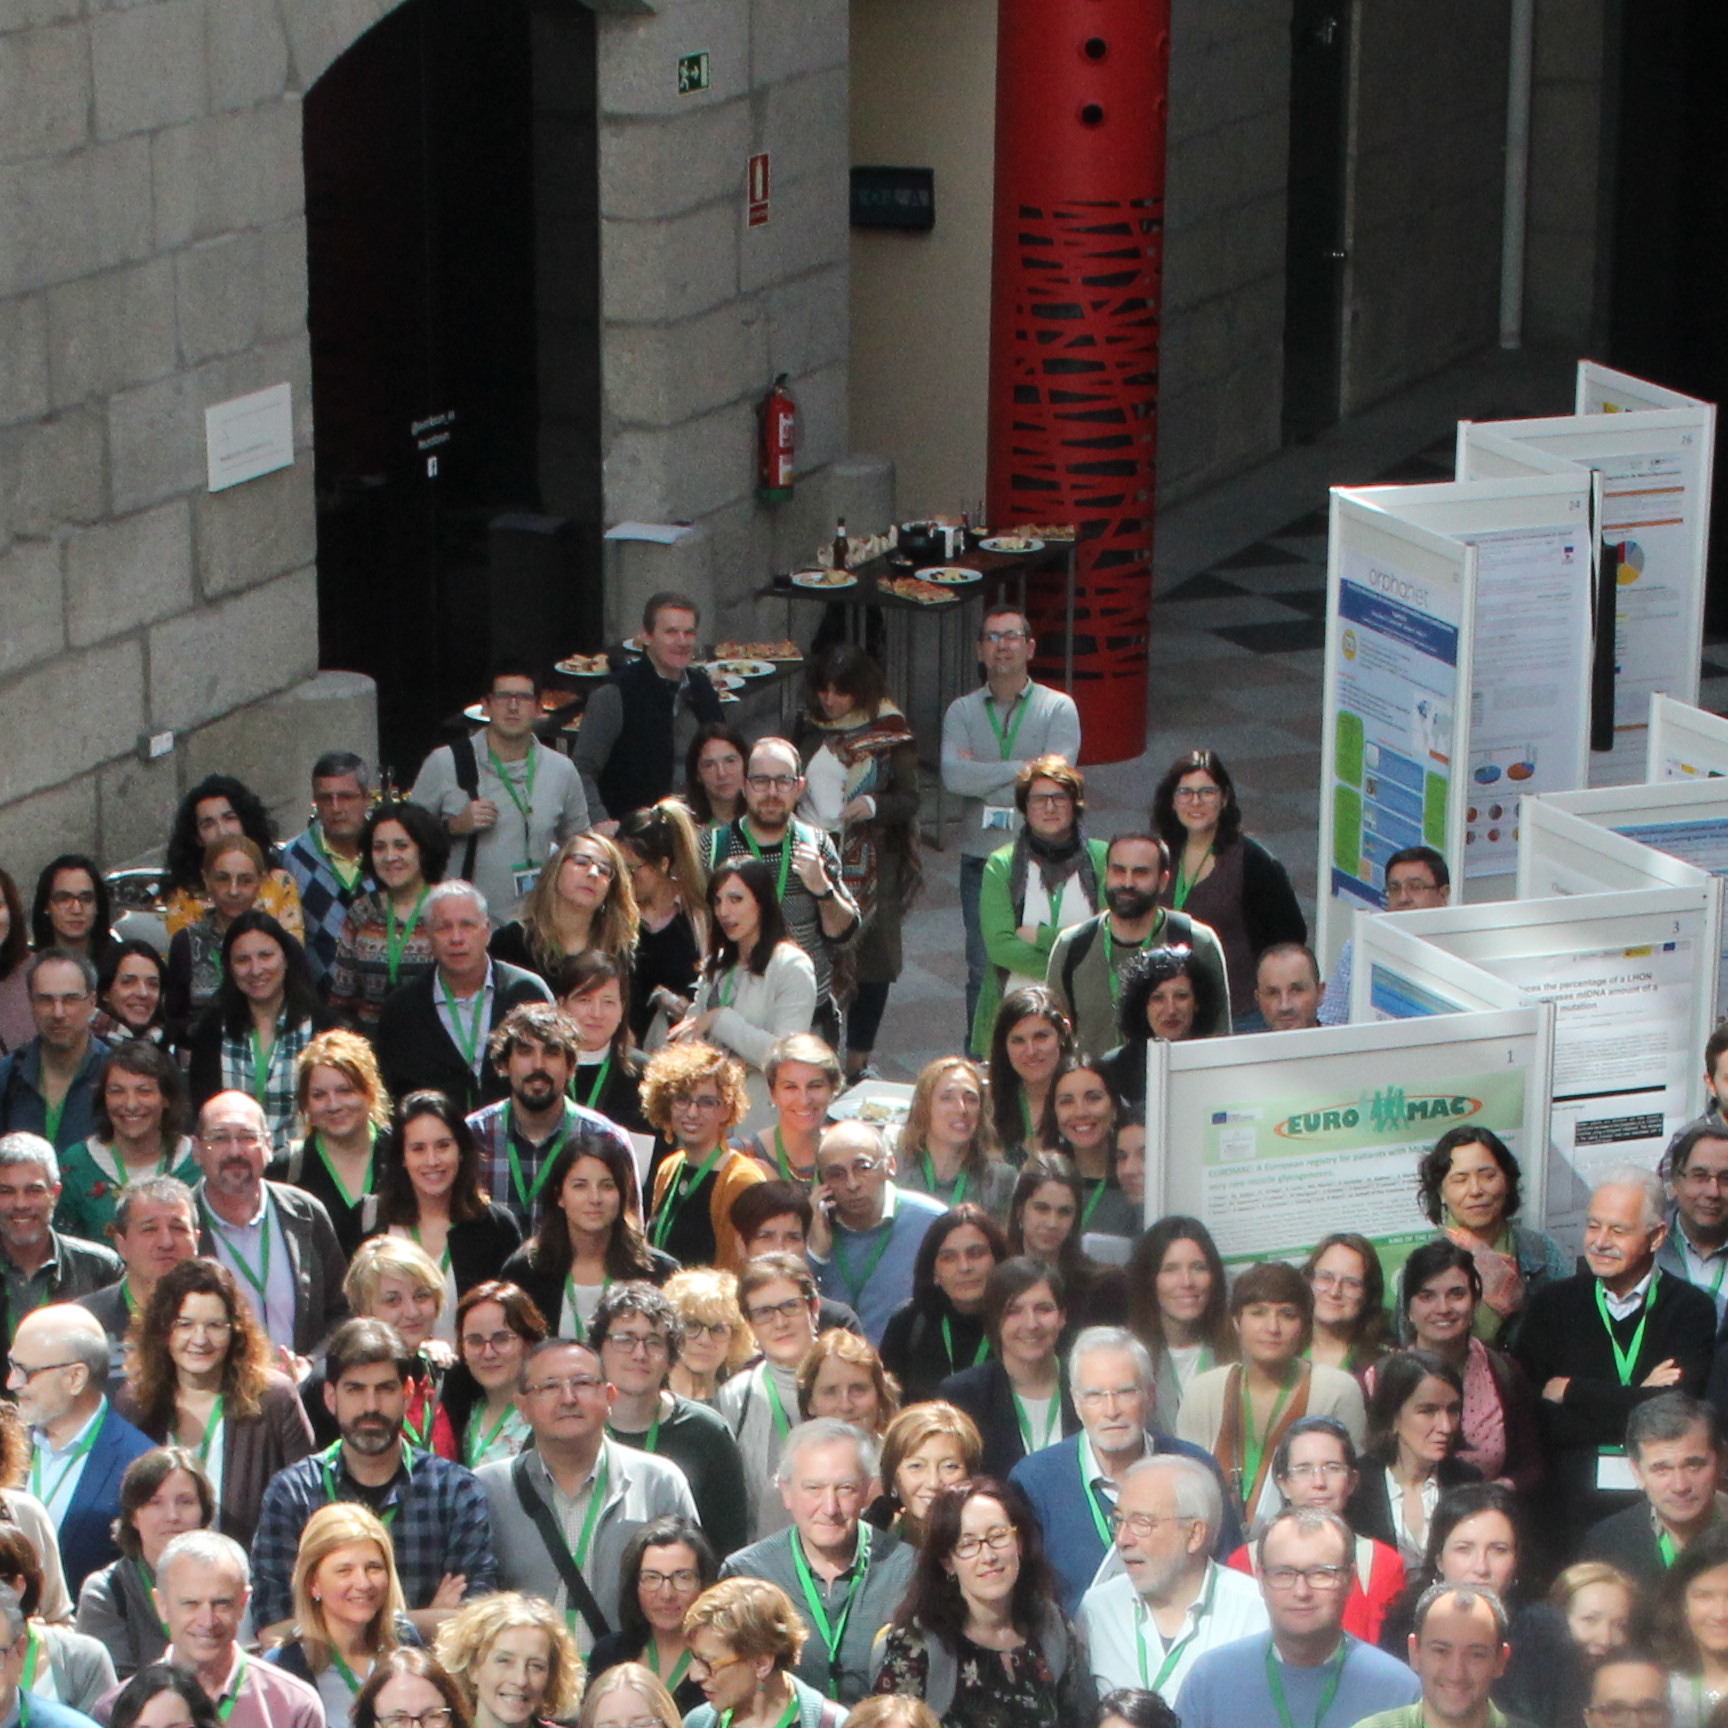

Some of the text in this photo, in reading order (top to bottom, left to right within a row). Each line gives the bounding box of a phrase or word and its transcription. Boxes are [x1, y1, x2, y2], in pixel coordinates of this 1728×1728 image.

[1672, 920, 1681, 934] 3
[1558, 978, 1607, 991] percentage
[1506, 1050, 1515, 1064] 1
[1286, 1096, 1468, 1134] EURO MAC
